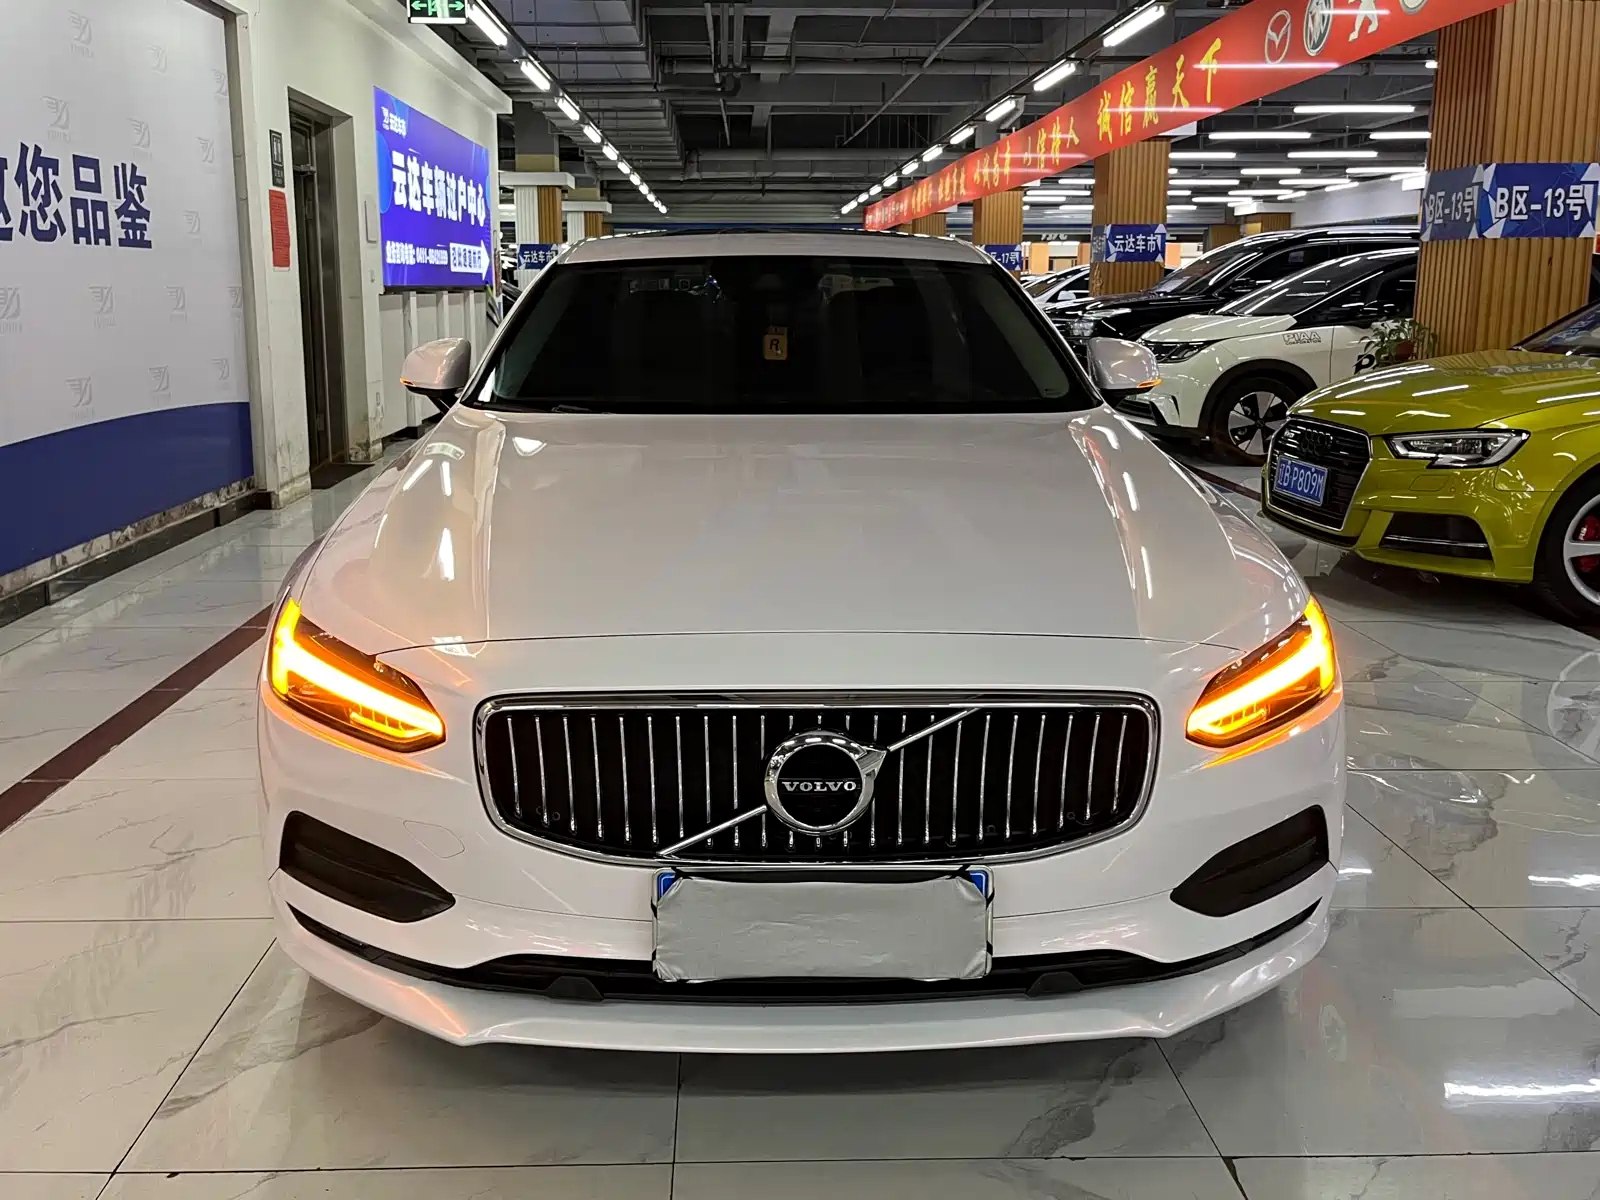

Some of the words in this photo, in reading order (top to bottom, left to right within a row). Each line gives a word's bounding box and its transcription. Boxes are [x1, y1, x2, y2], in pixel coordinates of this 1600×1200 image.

[1097, 38, 1222, 143] 诚信赢天下
[0, 141, 153, 249] 您品鉴
[392, 150, 486, 227] 云达车辆过户中心
[1425, 187, 1474, 225] B区-13号
[1494, 184, 1586, 222] B区-13号
[1114, 234, 1157, 253] 云达车市
[1283, 331, 1321, 343] PIAA
[781, 781, 857, 792] VOLVO
